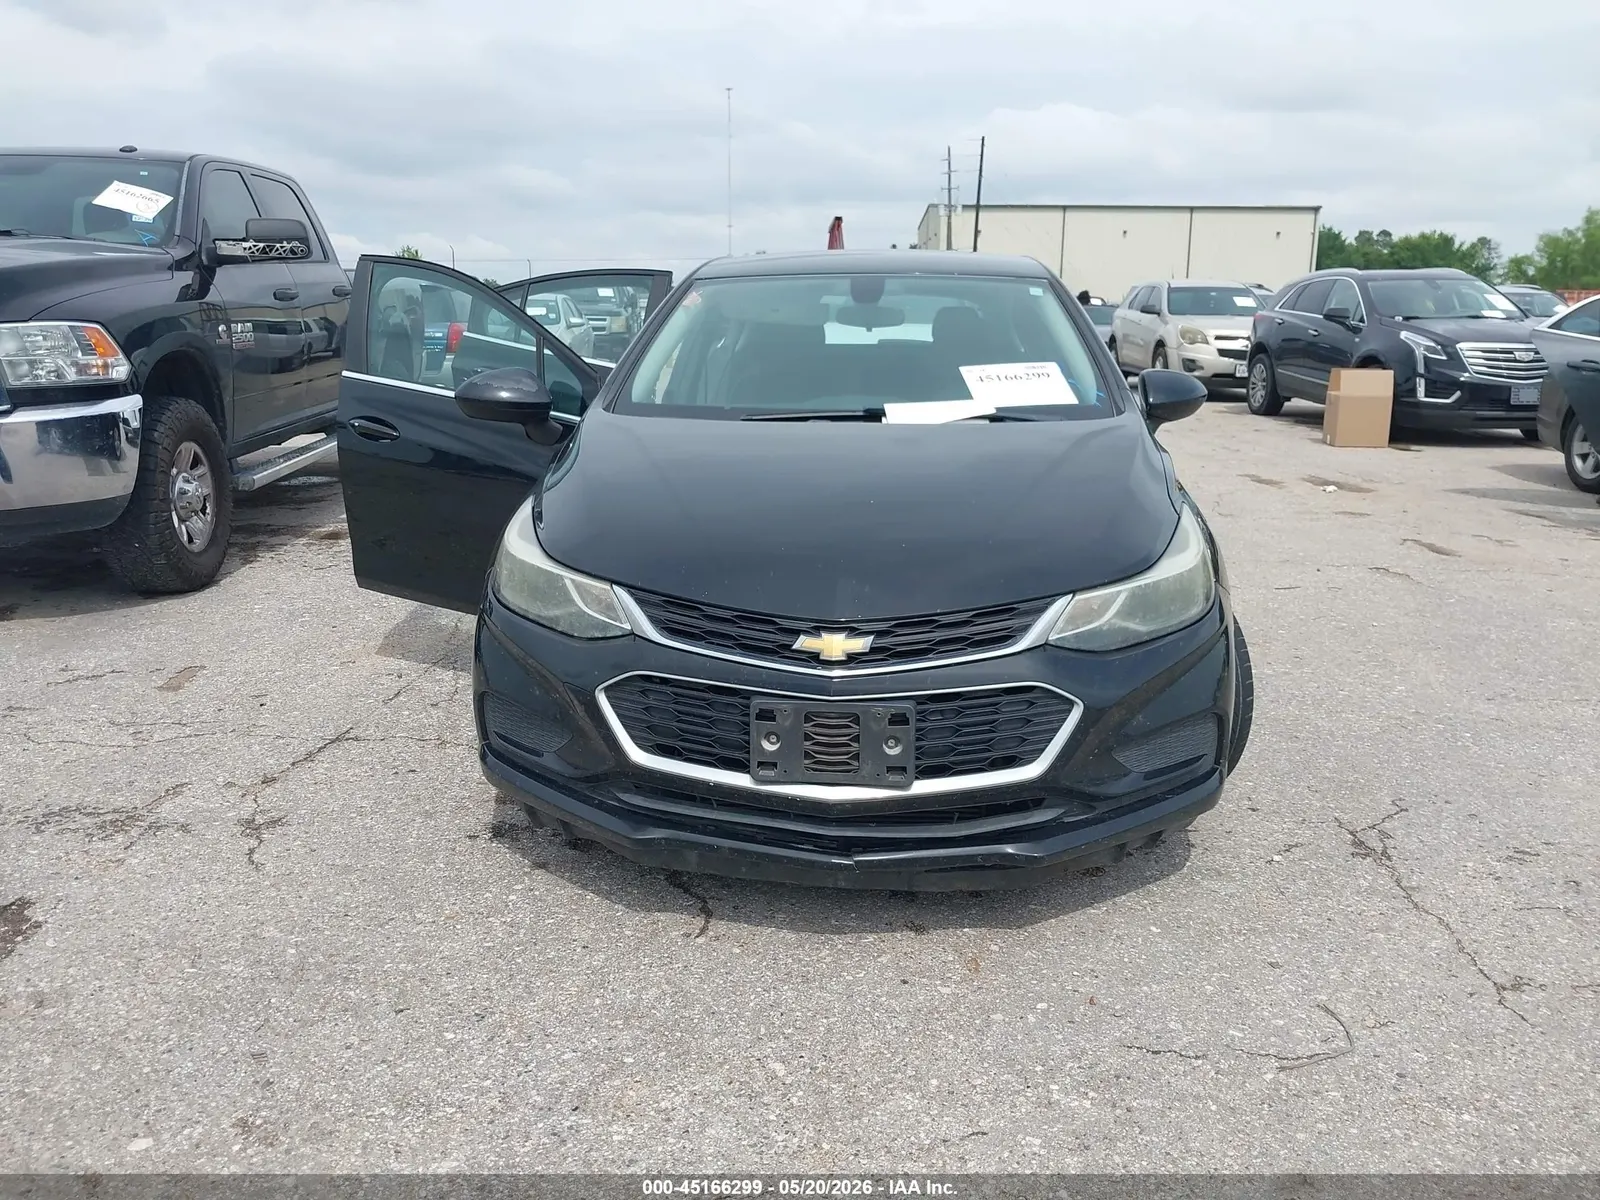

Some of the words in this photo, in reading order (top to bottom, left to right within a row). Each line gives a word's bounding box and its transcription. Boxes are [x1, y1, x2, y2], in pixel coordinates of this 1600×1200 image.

[230, 322, 253, 333] RAM
[232, 332, 254, 343] 2500
[976, 371, 1051, 383] 45166299
